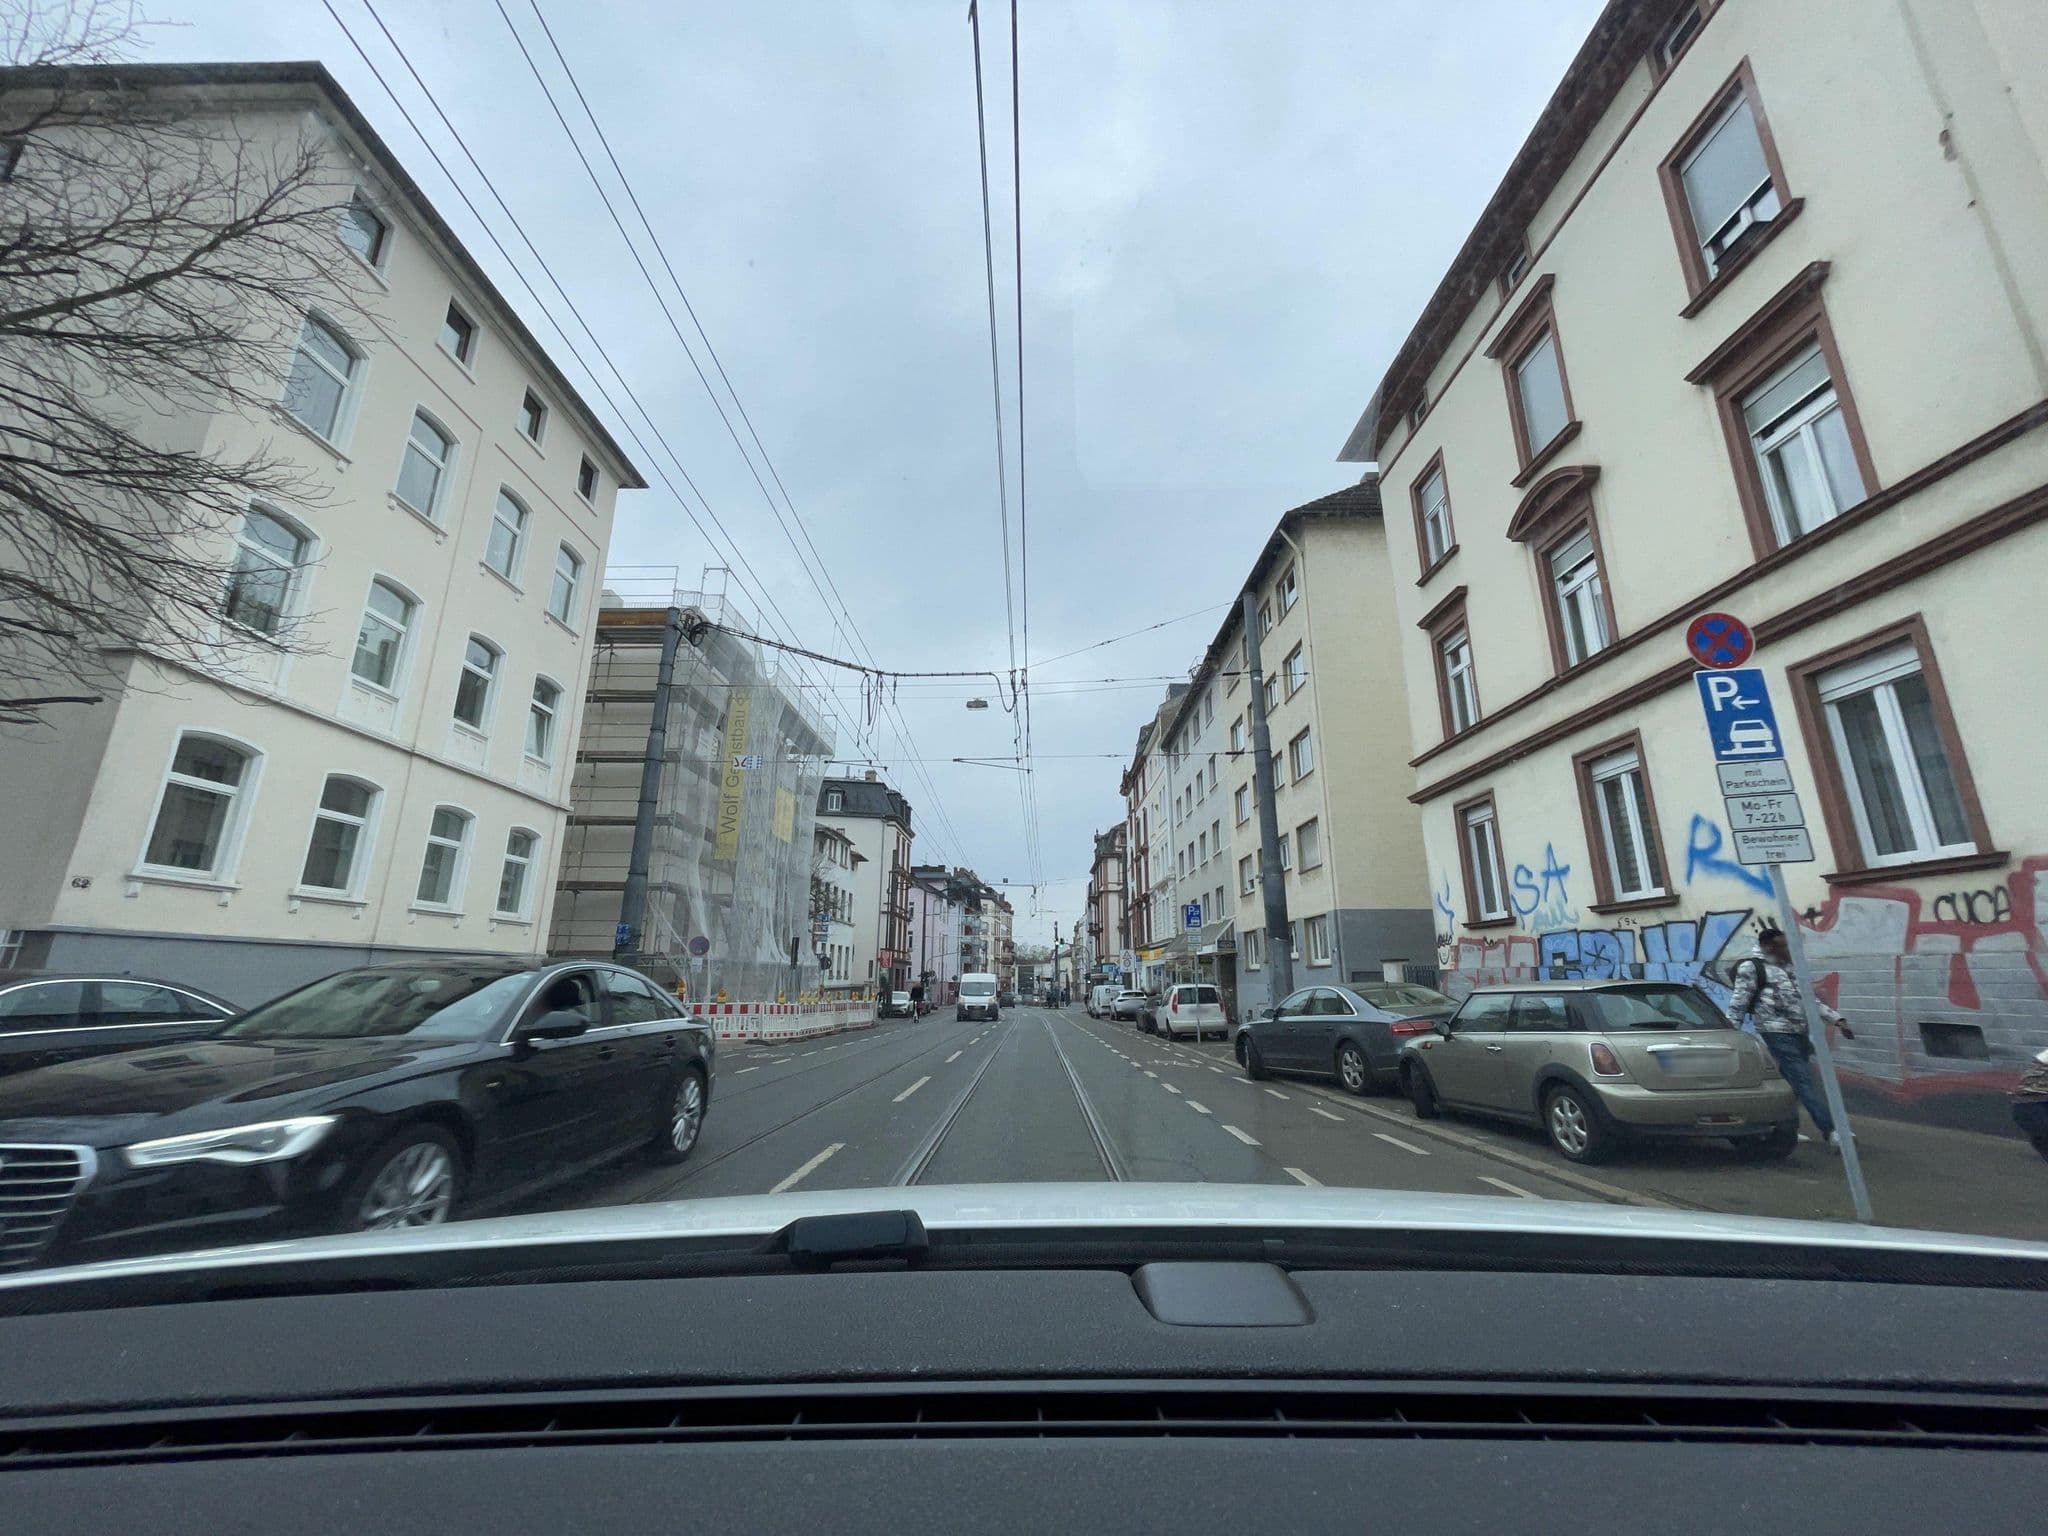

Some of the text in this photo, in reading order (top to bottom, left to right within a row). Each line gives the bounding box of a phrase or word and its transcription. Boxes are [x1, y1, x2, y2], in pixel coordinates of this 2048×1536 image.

[1707, 676, 1739, 711] P
[1744, 768, 1762, 777] mit
[1725, 777, 1788, 789] Parkschein
[719, 793, 740, 836] Wolf
[1741, 832, 1801, 844] Bewohner
